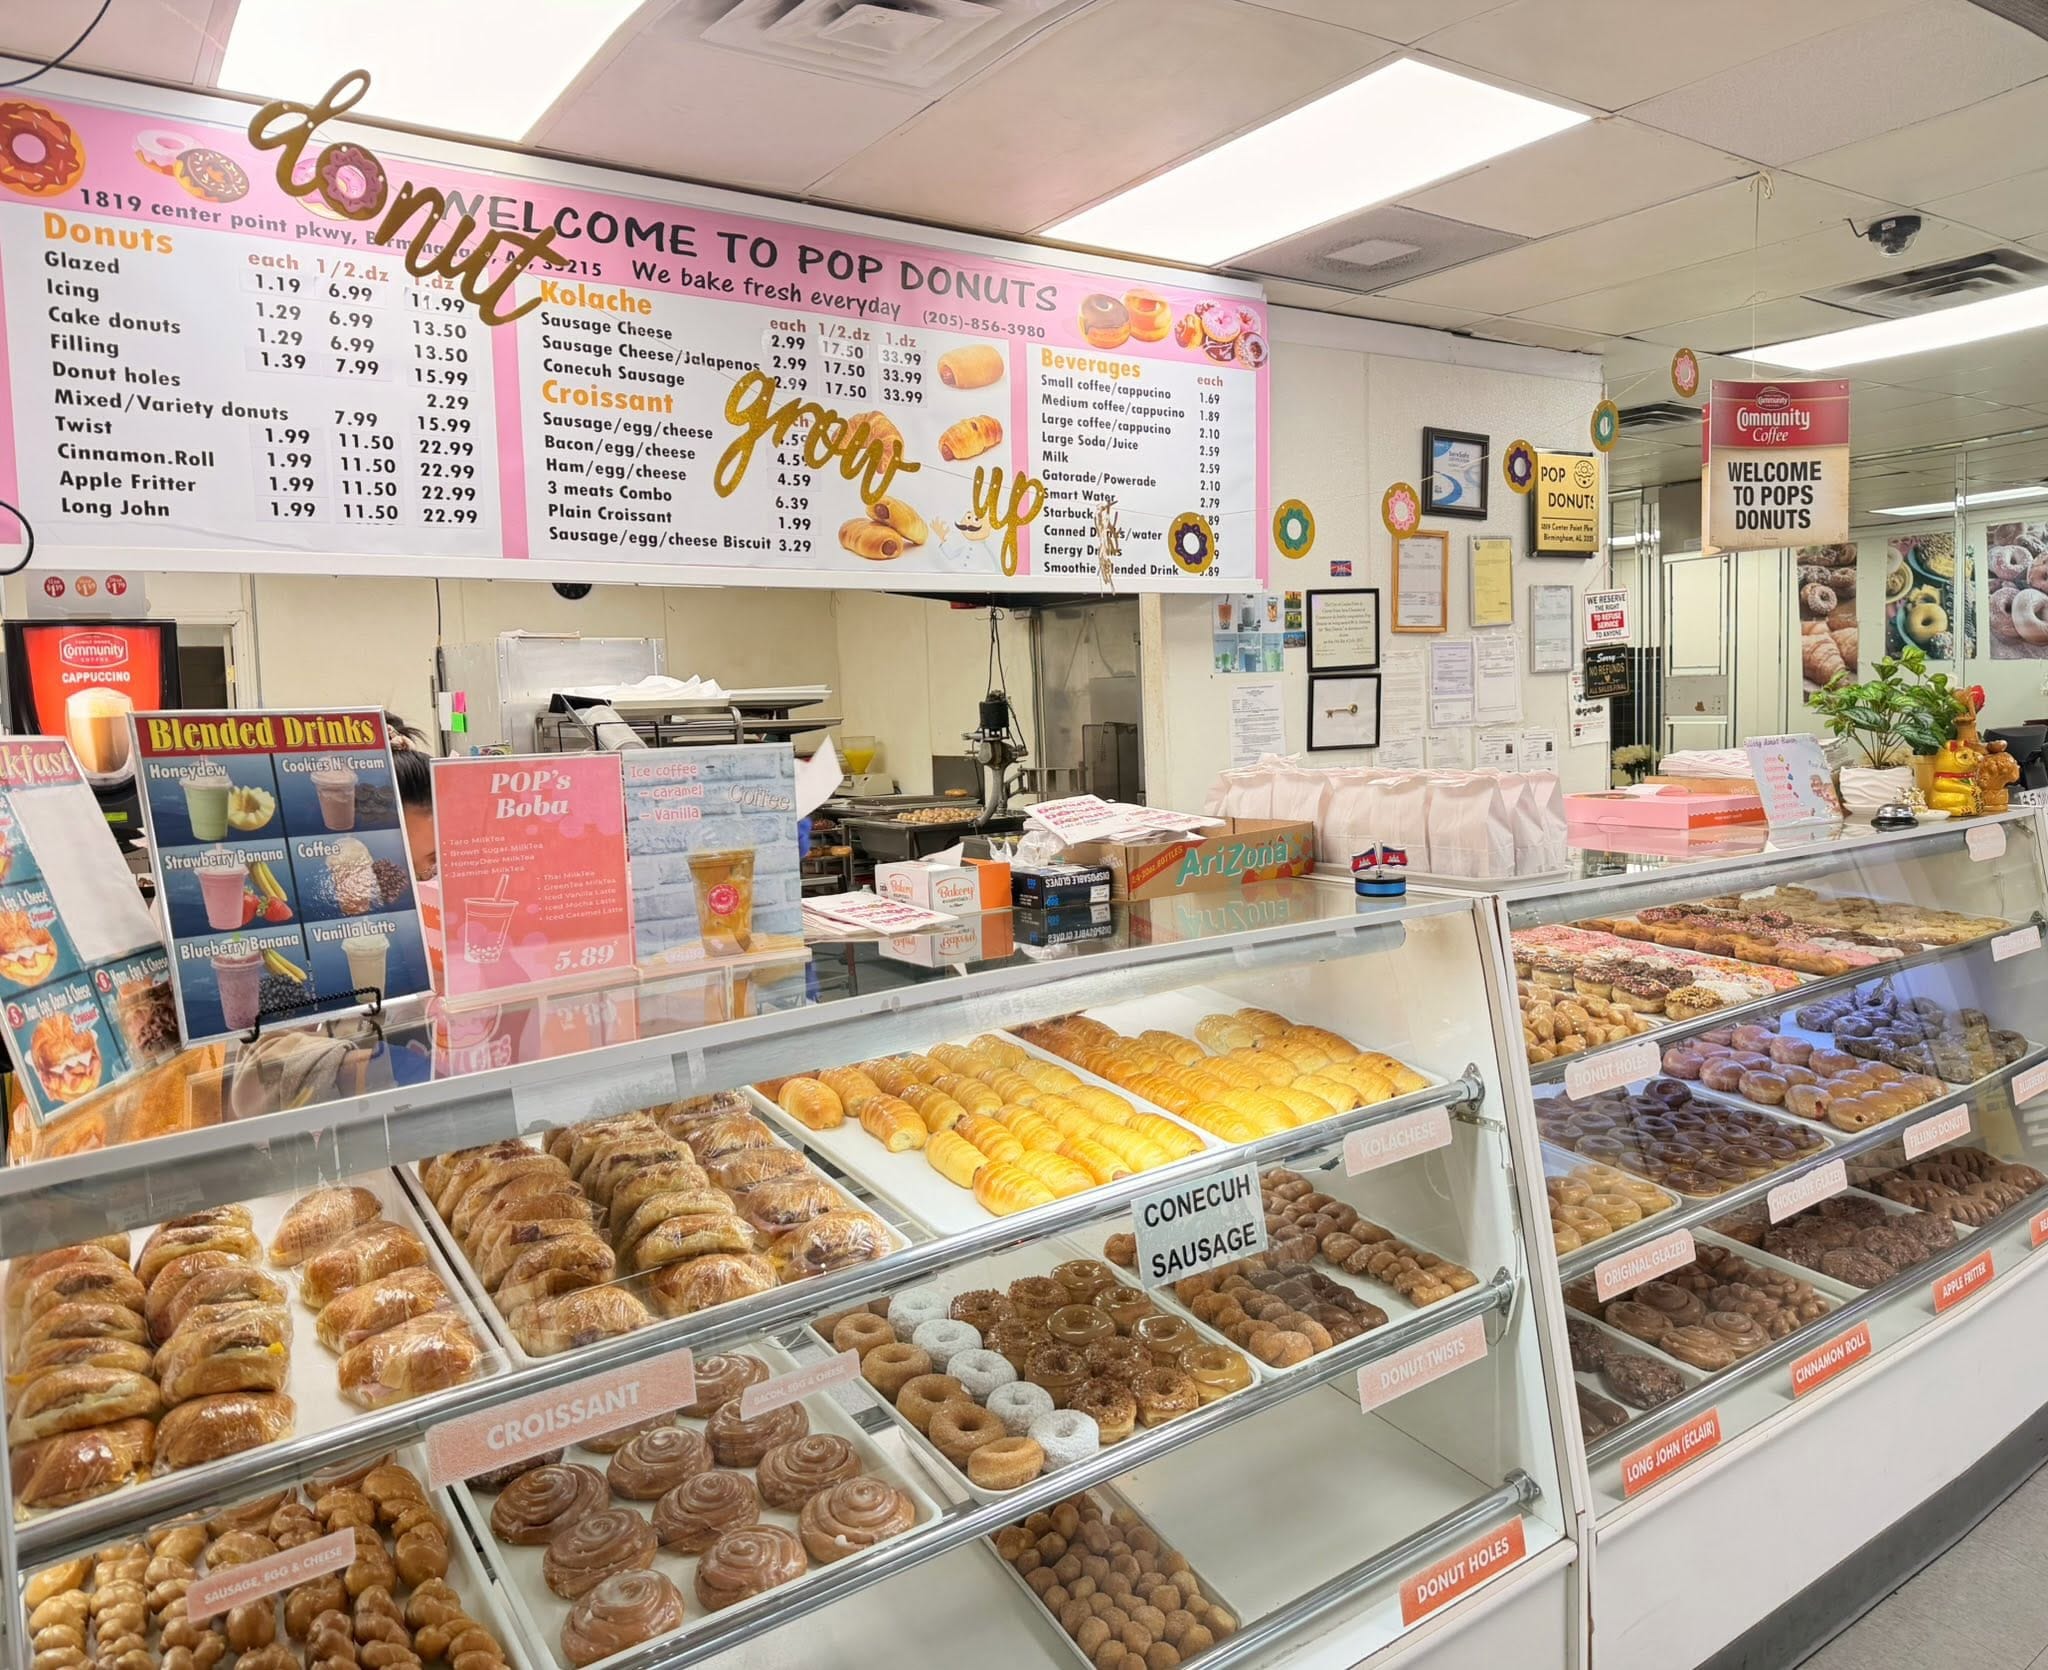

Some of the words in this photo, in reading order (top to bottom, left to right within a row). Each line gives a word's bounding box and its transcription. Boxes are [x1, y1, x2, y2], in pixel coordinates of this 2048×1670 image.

[80, 188, 142, 212] 1819
[151, 200, 222, 224] center
[230, 213, 288, 233] point
[296, 220, 358, 246] pkwy,
[44, 211, 174, 255] Donuts
[44, 250, 120, 275] Glazed
[442, 189, 698, 257] WELCOME
[717, 231, 778, 268] TO
[797, 244, 883, 284] POP
[900, 261, 1057, 312] DONUTS
[248, 253, 300, 271] each
[316, 258, 389, 283] 1/2.dz
[47, 278, 99, 303] Icing
[256, 274, 301, 294] 1.19
[328, 282, 373, 303] 6.99
[540, 280, 652, 316] Kolache
[632, 259, 671, 284] We
[681, 267, 735, 293] bake
[744, 277, 802, 303] fresh
[811, 290, 901, 322] everyday
[922, 310, 1046, 340] (205)-856-3980
[49, 306, 100, 326] Cake
[109, 311, 181, 334] donuts
[541, 311, 611, 336] Sausage
[617, 320, 673, 341] Cheese
[770, 318, 807, 333] each
[51, 333, 119, 359] Filling
[542, 334, 613, 359] Sausage
[618, 343, 761, 374] Cheese/Jalapenos
[771, 334, 806, 351] 2.99
[52, 360, 117, 382] Donut
[125, 366, 181, 387] holes
[261, 351, 307, 370] 1.39
[336, 358, 379, 376] 7.99
[414, 367, 468, 387] 15.99
[543, 357, 612, 379] Conecuh
[618, 366, 686, 388] Sausage
[1041, 347, 1141, 380] Beverages
[1041, 374, 1074, 390] Small
[1077, 380, 1172, 402] coffee/cappucino
[1196, 375, 1224, 388] each
[54, 388, 214, 419] Mixed/Variety
[221, 401, 290, 421] donuts
[542, 379, 674, 415] Croissant
[1042, 393, 1089, 410] Medium
[1092, 400, 1185, 420] coffee/cappucino
[1199, 391, 1220, 405] 1.69
[55, 415, 113, 435] Twist
[543, 411, 714, 441] Sausage/egg/cheese
[1042, 412, 1074, 429] Large
[1077, 417, 1172, 436] coffee/cappucino
[1736, 407, 1811, 432] Community
[266, 428, 311, 445] 1.99
[338, 433, 395, 451] 11.50
[419, 439, 474, 457] 22.99
[545, 435, 697, 461] Bacon/egg/cheese
[1042, 431, 1074, 448] Large
[1078, 434, 1139, 451] Soda/Juice
[1752, 426, 1789, 446] Coffee
[57, 443, 215, 468] Cinnamon.Roll
[1042, 450, 1069, 464] Milk
[59, 471, 122, 492] Apple
[131, 474, 197, 493] Fritter
[546, 457, 687, 483] Ham/egg/cheese
[777, 472, 811, 488] 4.59
[1042, 469, 1157, 489] Gatorade/Powerade
[1541, 466, 1566, 483] POP
[1728, 461, 1823, 483] WELCOME
[547, 481, 558, 496] 3
[564, 482, 614, 499] meats
[619, 484, 673, 502] Combo
[1733, 485, 1755, 507] TO
[1760, 485, 1814, 506] POPS
[61, 497, 112, 519] Long
[120, 501, 171, 518] John
[548, 503, 592, 520] Plain
[598, 506, 673, 524] Croissant
[1735, 509, 1812, 531] DONUTS
[549, 527, 719, 549] Sausage/egg/cheese
[723, 534, 772, 551] Biscuit
[778, 539, 812, 553] 3.29
[63, 643, 124, 660] Community
[62, 671, 131, 684] CAPPUCCINO
[147, 716, 277, 751] Blended
[282, 715, 376, 747] Drinks
[150, 763, 227, 780] Honeydew
[282, 757, 330, 773] Cookies
[347, 757, 385, 771] Cream
[630, 766, 651, 778] Ice
[656, 763, 697, 777] coffee
[490, 769, 572, 795] POP's
[653, 785, 704, 799] caramel
[496, 798, 569, 820] Boba
[654, 807, 699, 821] Vanilla
[165, 853, 235, 871] Strawberry
[237, 848, 284, 866] Banana
[298, 841, 340, 859] Coffee
[1176, 841, 1289, 888] AriZona
[937, 883, 974, 900] Bakery
[313, 925, 361, 943] Vanilla
[362, 921, 397, 938] Latte
[180, 940, 248, 961] Blueberry
[250, 933, 299, 951] Banana
[1144, 1174, 1251, 1228] CONECUH
[1152, 1222, 1257, 1279] SAUSAGE
[1604, 1255, 1652, 1286] ORIGINAL
[1652, 1240, 1687, 1266] GLAZED
[1943, 1276, 1964, 1299] APPLE
[1964, 1262, 1986, 1286] FRITTER
[1381, 1355, 1425, 1388] DONUT
[1425, 1337, 1466, 1368] TWISTS
[1795, 1344, 1845, 1384] CINNAMON
[1845, 1332, 1866, 1355] ROLL
[486, 1381, 640, 1451] CROISSANT
[1627, 1455, 1655, 1483] LONG
[1655, 1439, 1681, 1467] JOHN
[1682, 1419, 1716, 1454] (ÉCLAIR)
[204, 1576, 261, 1605] SAUSAGE,
[264, 1566, 289, 1583] EGG
[291, 1562, 301, 1574] &
[303, 1546, 343, 1569] CHEESE
[1417, 1561, 1466, 1604] DONUT
[1469, 1535, 1510, 1575] HOLES
